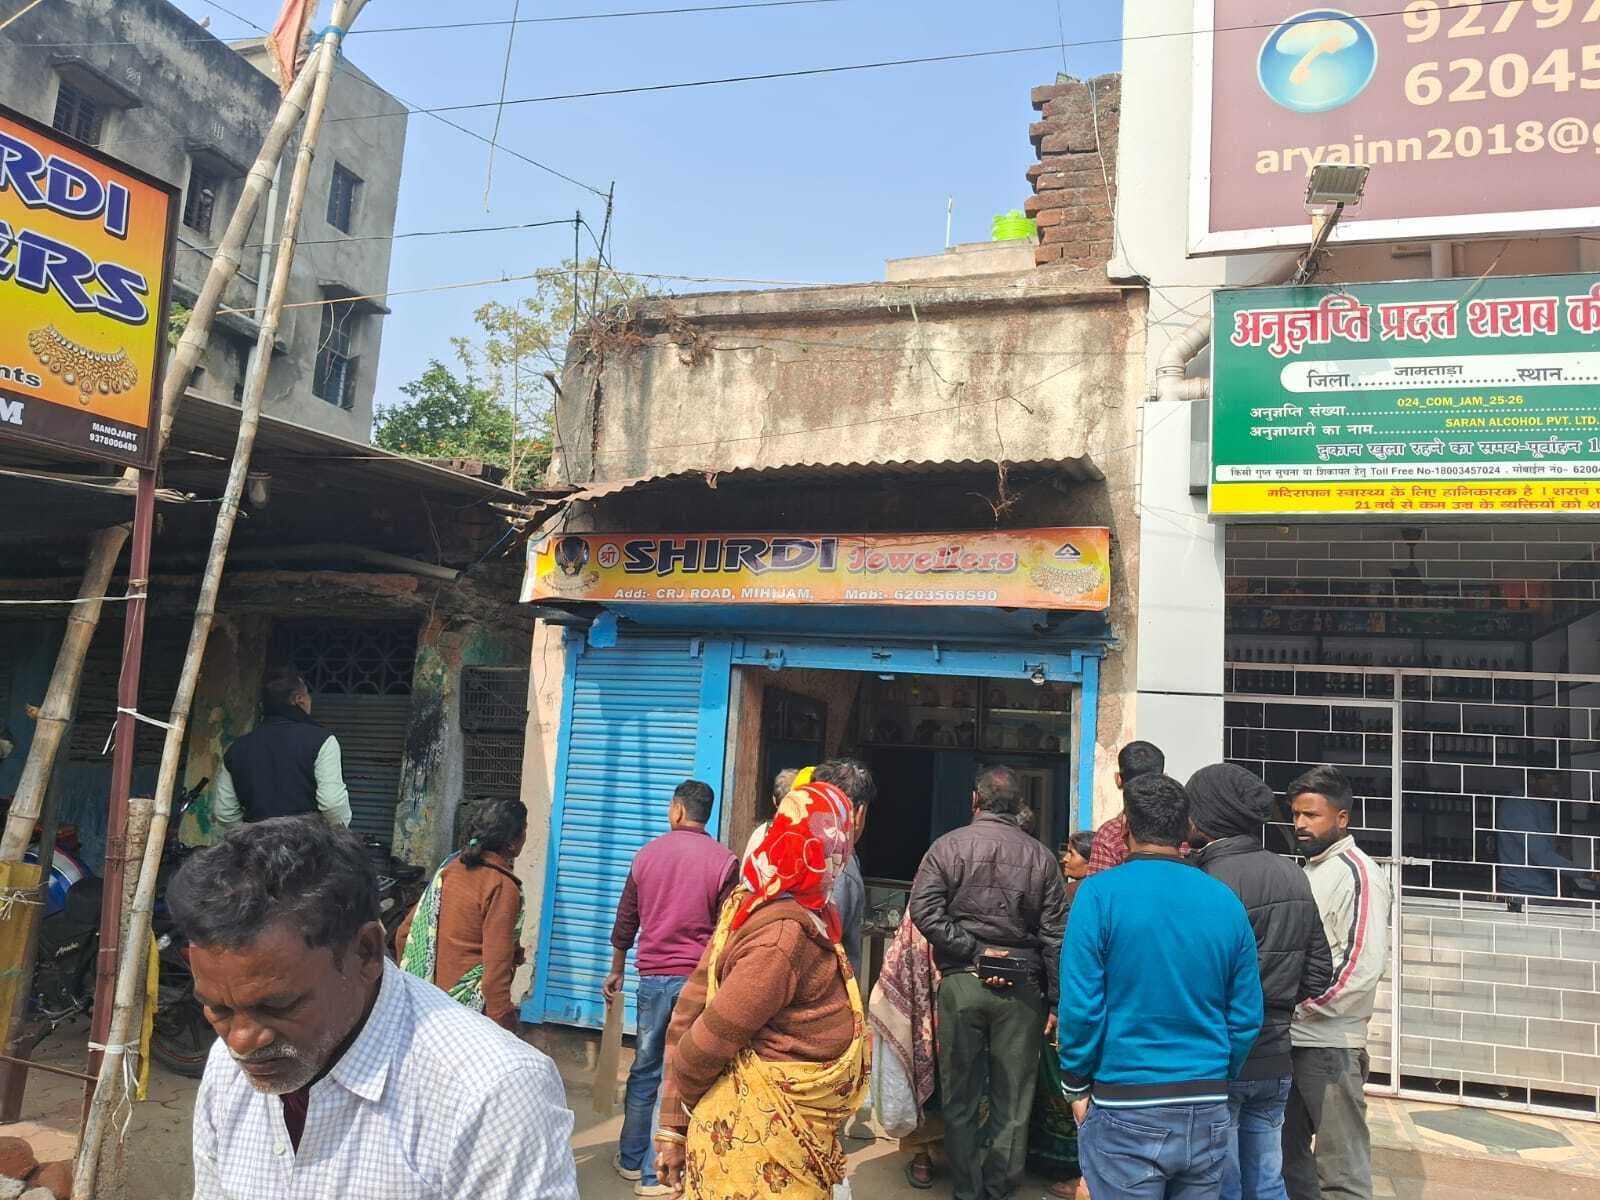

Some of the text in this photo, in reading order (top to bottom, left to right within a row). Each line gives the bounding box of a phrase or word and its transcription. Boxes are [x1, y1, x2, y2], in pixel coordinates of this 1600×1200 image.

[1404, 45, 1600, 106] 62045
[1255, 117, 1600, 177] aryainn2018@
[1466, 296, 1560, 338] शराब
[1307, 369, 1350, 388] जिला
[1516, 367, 1563, 382] स्थान
[1322, 425, 1340, 435] का
[1347, 424, 1374, 435] नाम
[1445, 418, 1486, 428] SARAN
[1488, 416, 1543, 427] ALCOHOL
[1546, 416, 1572, 425] PVT.
[1316, 444, 1363, 461] दुकान
[1367, 443, 1406, 460] खुला
[1409, 437, 1445, 456] रहने
[1448, 442, 1474, 455] का
[1588, 437, 1600, 452] 1
[1371, 467, 1388, 476] Toll
[1391, 467, 1414, 475] Free
[1355, 500, 1370, 509] 21
[623, 537, 838, 576] SHIRDI
[847, 544, 1019, 573] Jewellers
[656, 588, 686, 600] CRJ
